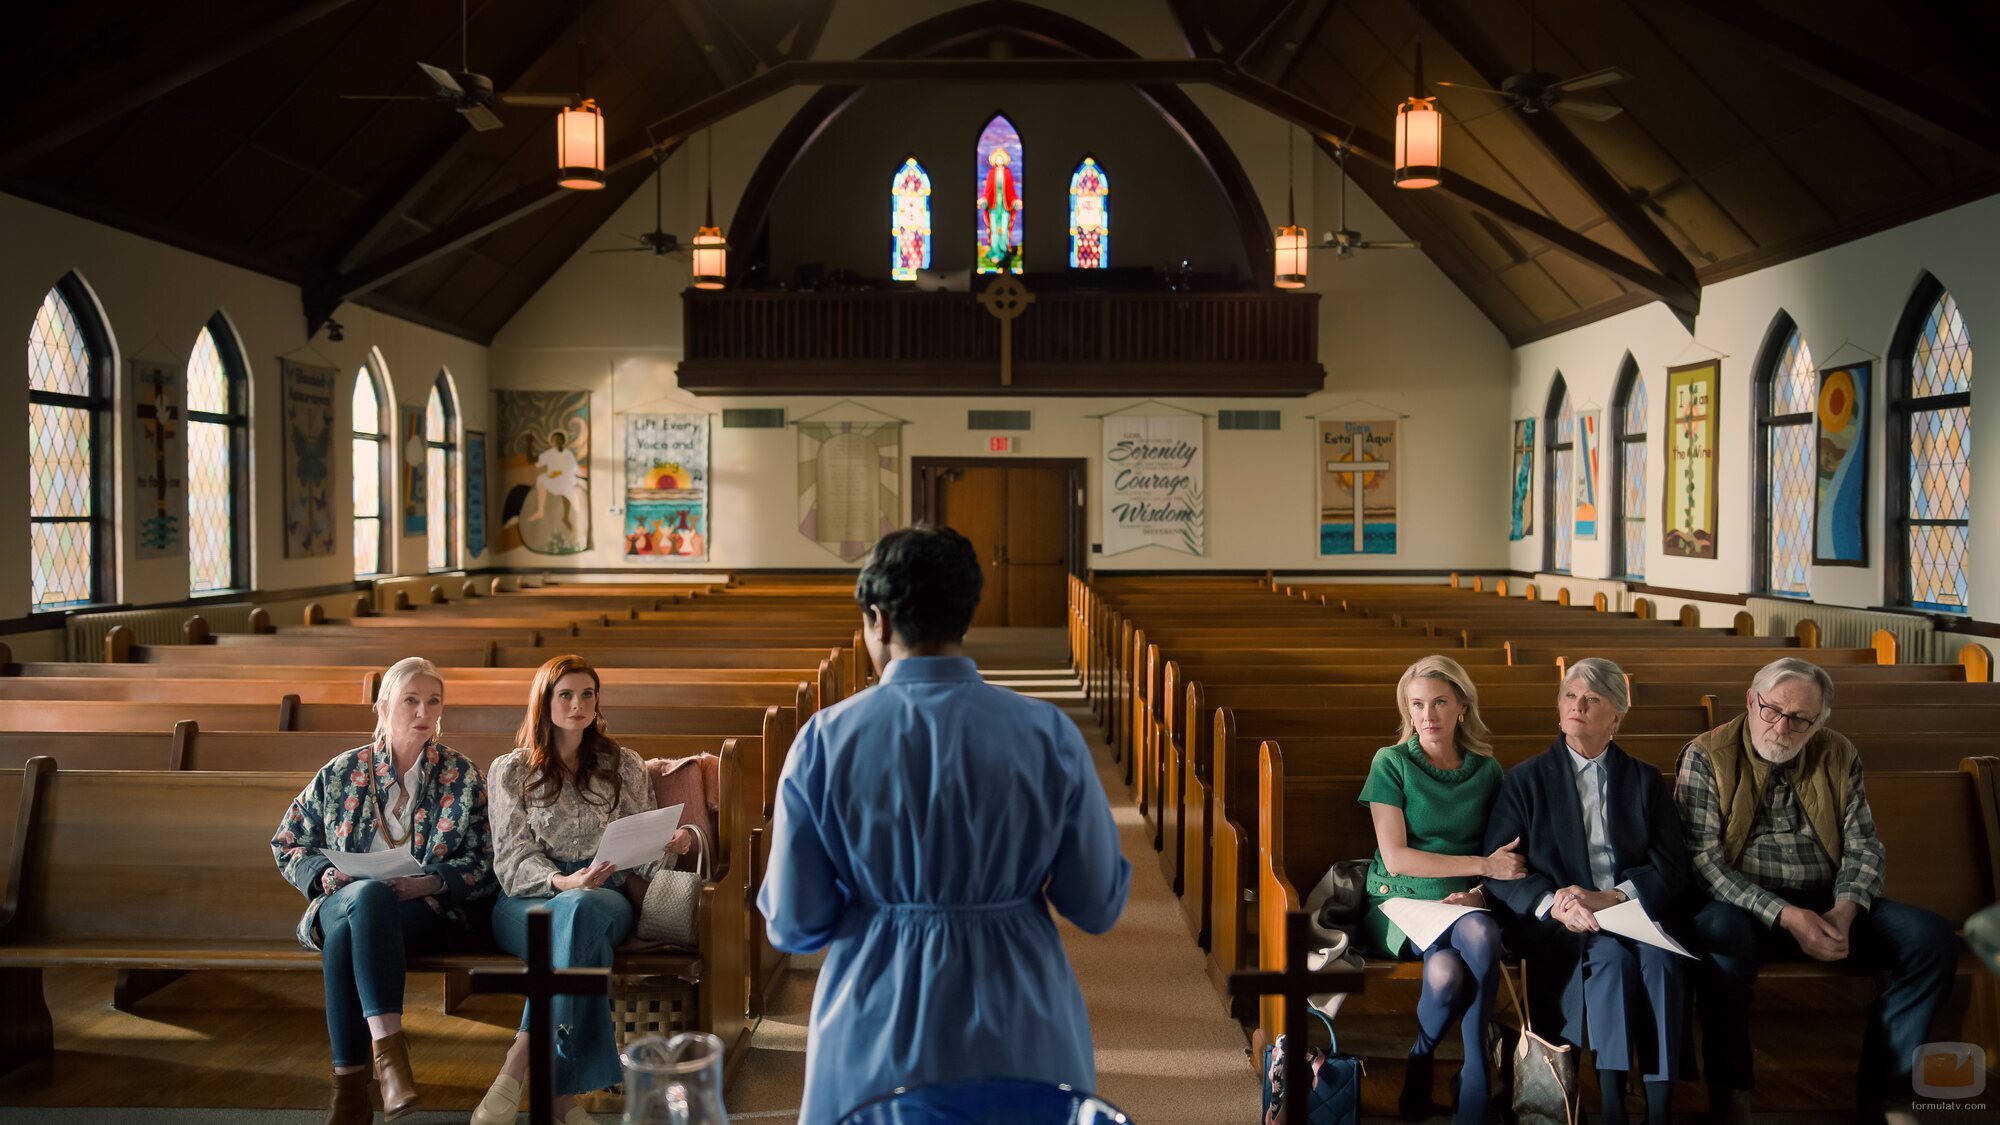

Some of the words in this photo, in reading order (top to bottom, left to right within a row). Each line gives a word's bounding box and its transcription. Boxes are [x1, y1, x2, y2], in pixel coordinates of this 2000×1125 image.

[1679, 391, 1684, 408] I
[634, 418, 656, 431] Lift
[663, 419, 699, 437] Every
[637, 439, 669, 449] Voice
[672, 439, 694, 449] and
[990, 437, 1008, 451] EXIT
[1107, 440, 1198, 469] Serenity
[1673, 446, 1686, 460] the
[653, 457, 680, 473] Sing
[1114, 468, 1190, 496] Courage
[1111, 501, 1193, 523] Wisdom
